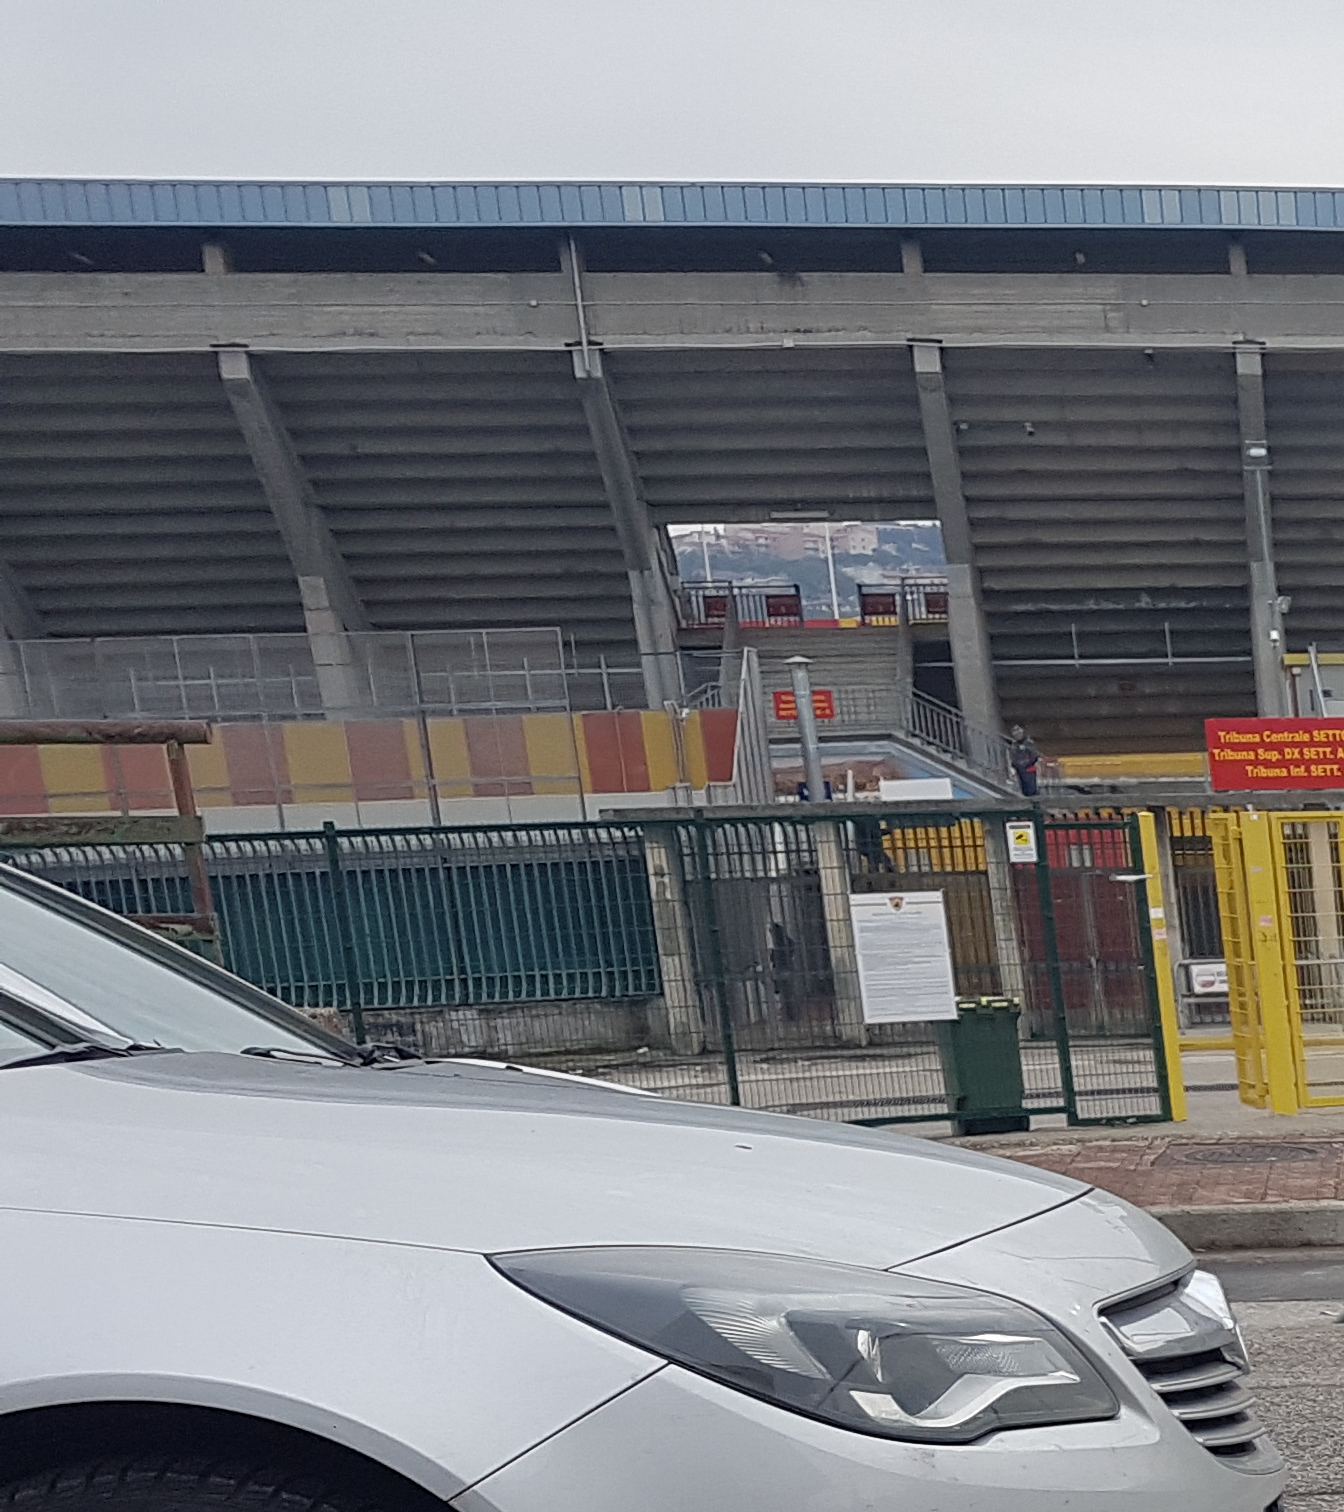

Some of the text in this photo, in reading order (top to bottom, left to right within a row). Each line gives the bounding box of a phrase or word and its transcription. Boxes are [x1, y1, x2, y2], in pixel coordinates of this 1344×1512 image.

[1218, 731, 1260, 743] Tribuna
[1263, 730, 1310, 742] Centrale
[1213, 748, 1255, 760] Tribuna
[1257, 748, 1282, 762] Sup.
[1284, 747, 1300, 759] DX
[1302, 747, 1335, 759] SETT.
[1337, 747, 1344, 759] A
[1245, 765, 1288, 777] Tribuna
[1310, 764, 1342, 776] SETT.
